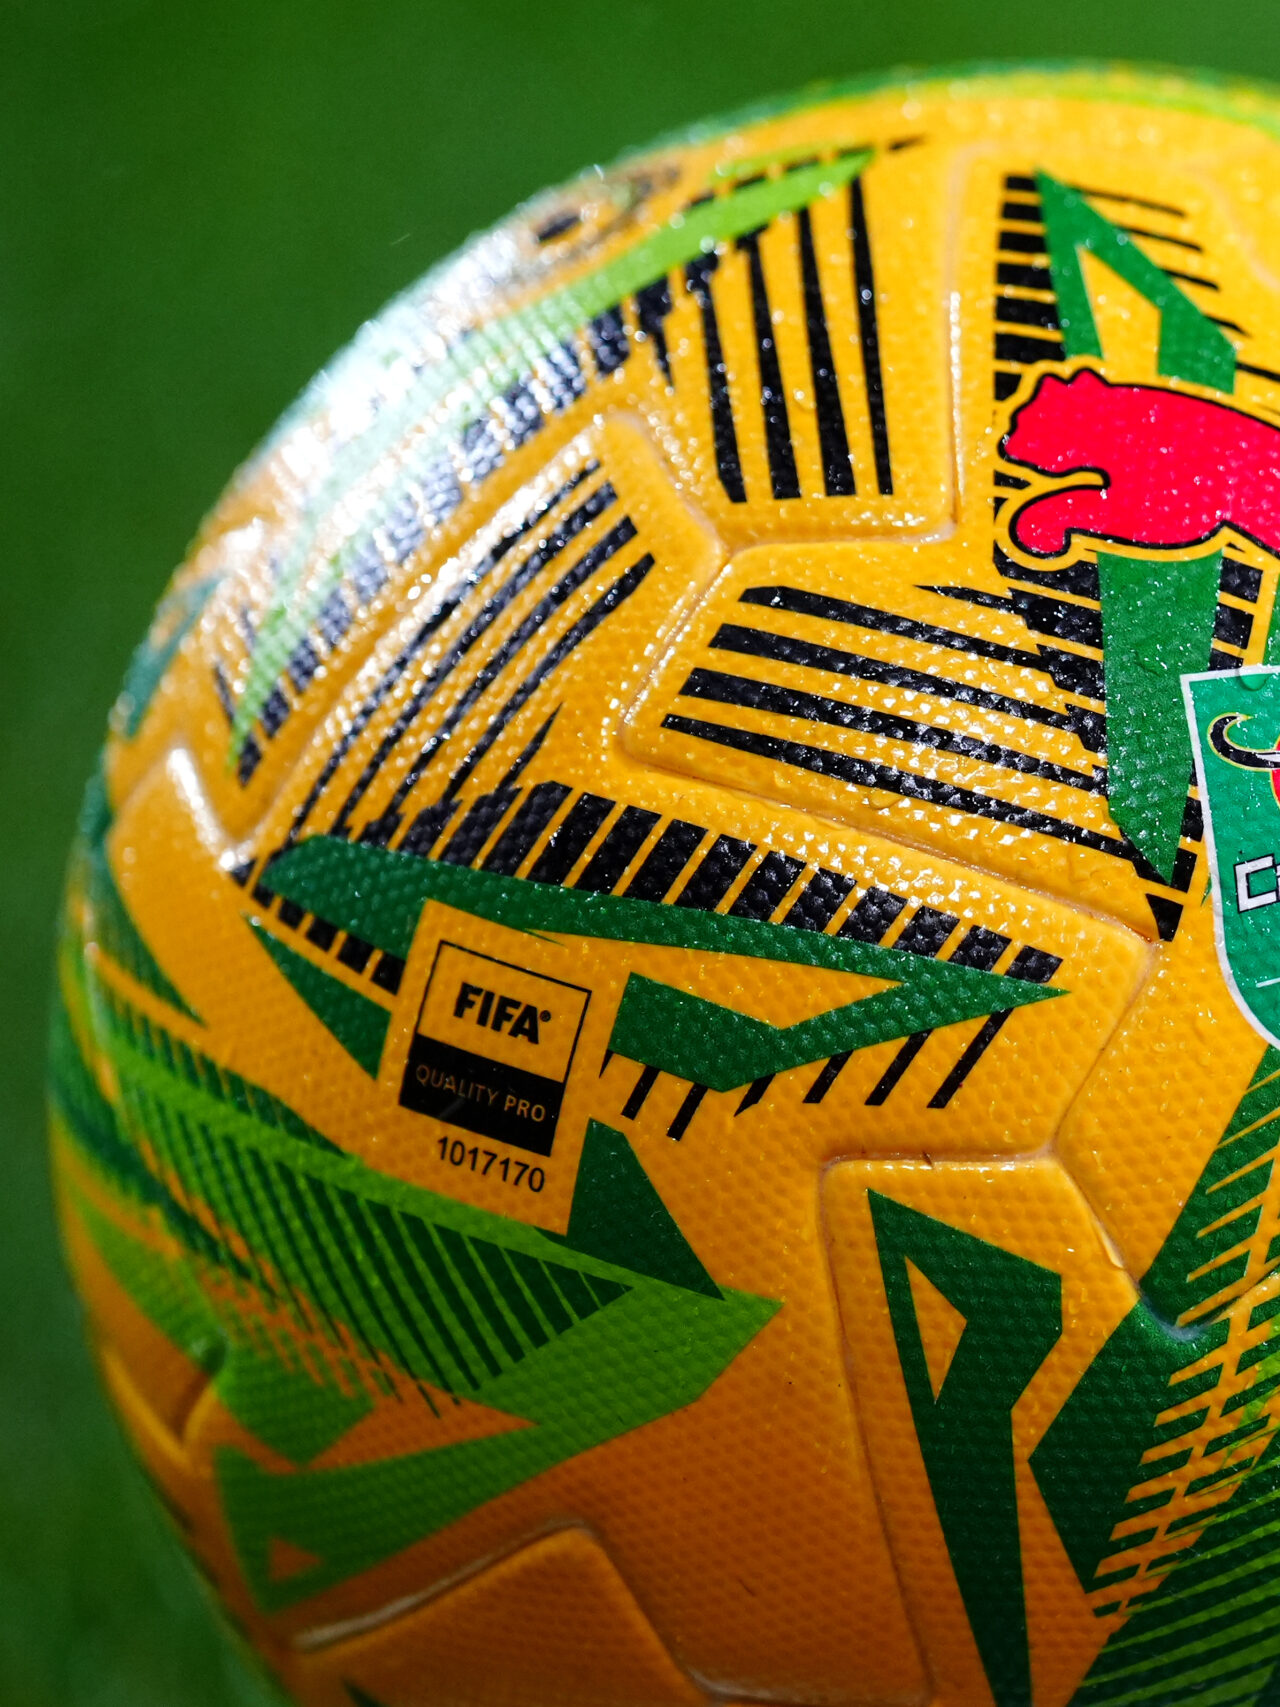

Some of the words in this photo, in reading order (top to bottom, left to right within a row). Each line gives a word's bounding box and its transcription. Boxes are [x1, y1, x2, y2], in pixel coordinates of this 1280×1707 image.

[416, 1064, 499, 1106] QUALITY
[504, 1094, 546, 1122] PRO
[438, 1136, 545, 1193] 1017170
